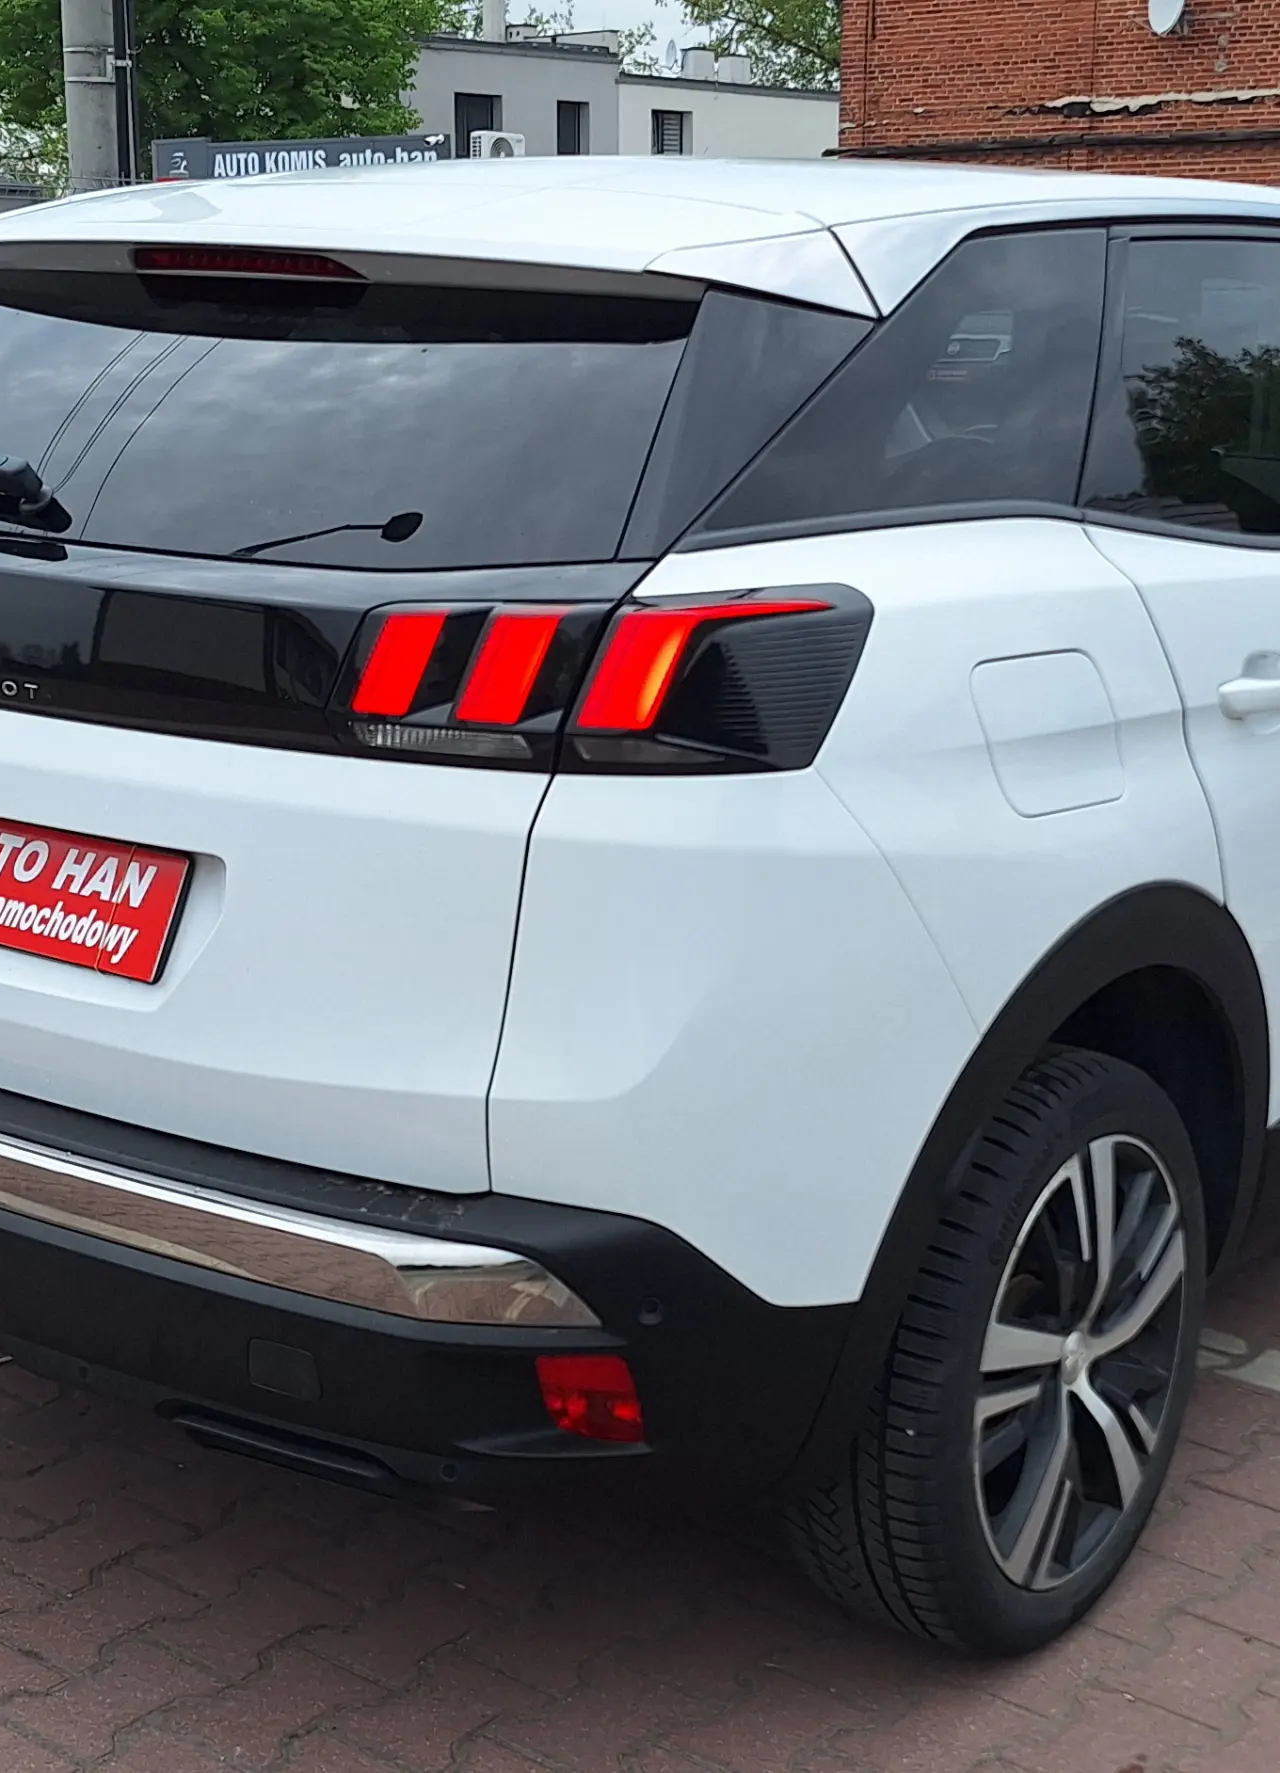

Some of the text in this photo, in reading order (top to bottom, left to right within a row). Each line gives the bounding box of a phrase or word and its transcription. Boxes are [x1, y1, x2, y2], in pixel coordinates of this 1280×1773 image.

[214, 152, 260, 177] AUTO
[265, 149, 327, 174] KOMIS
[52, 847, 158, 908] HAN
